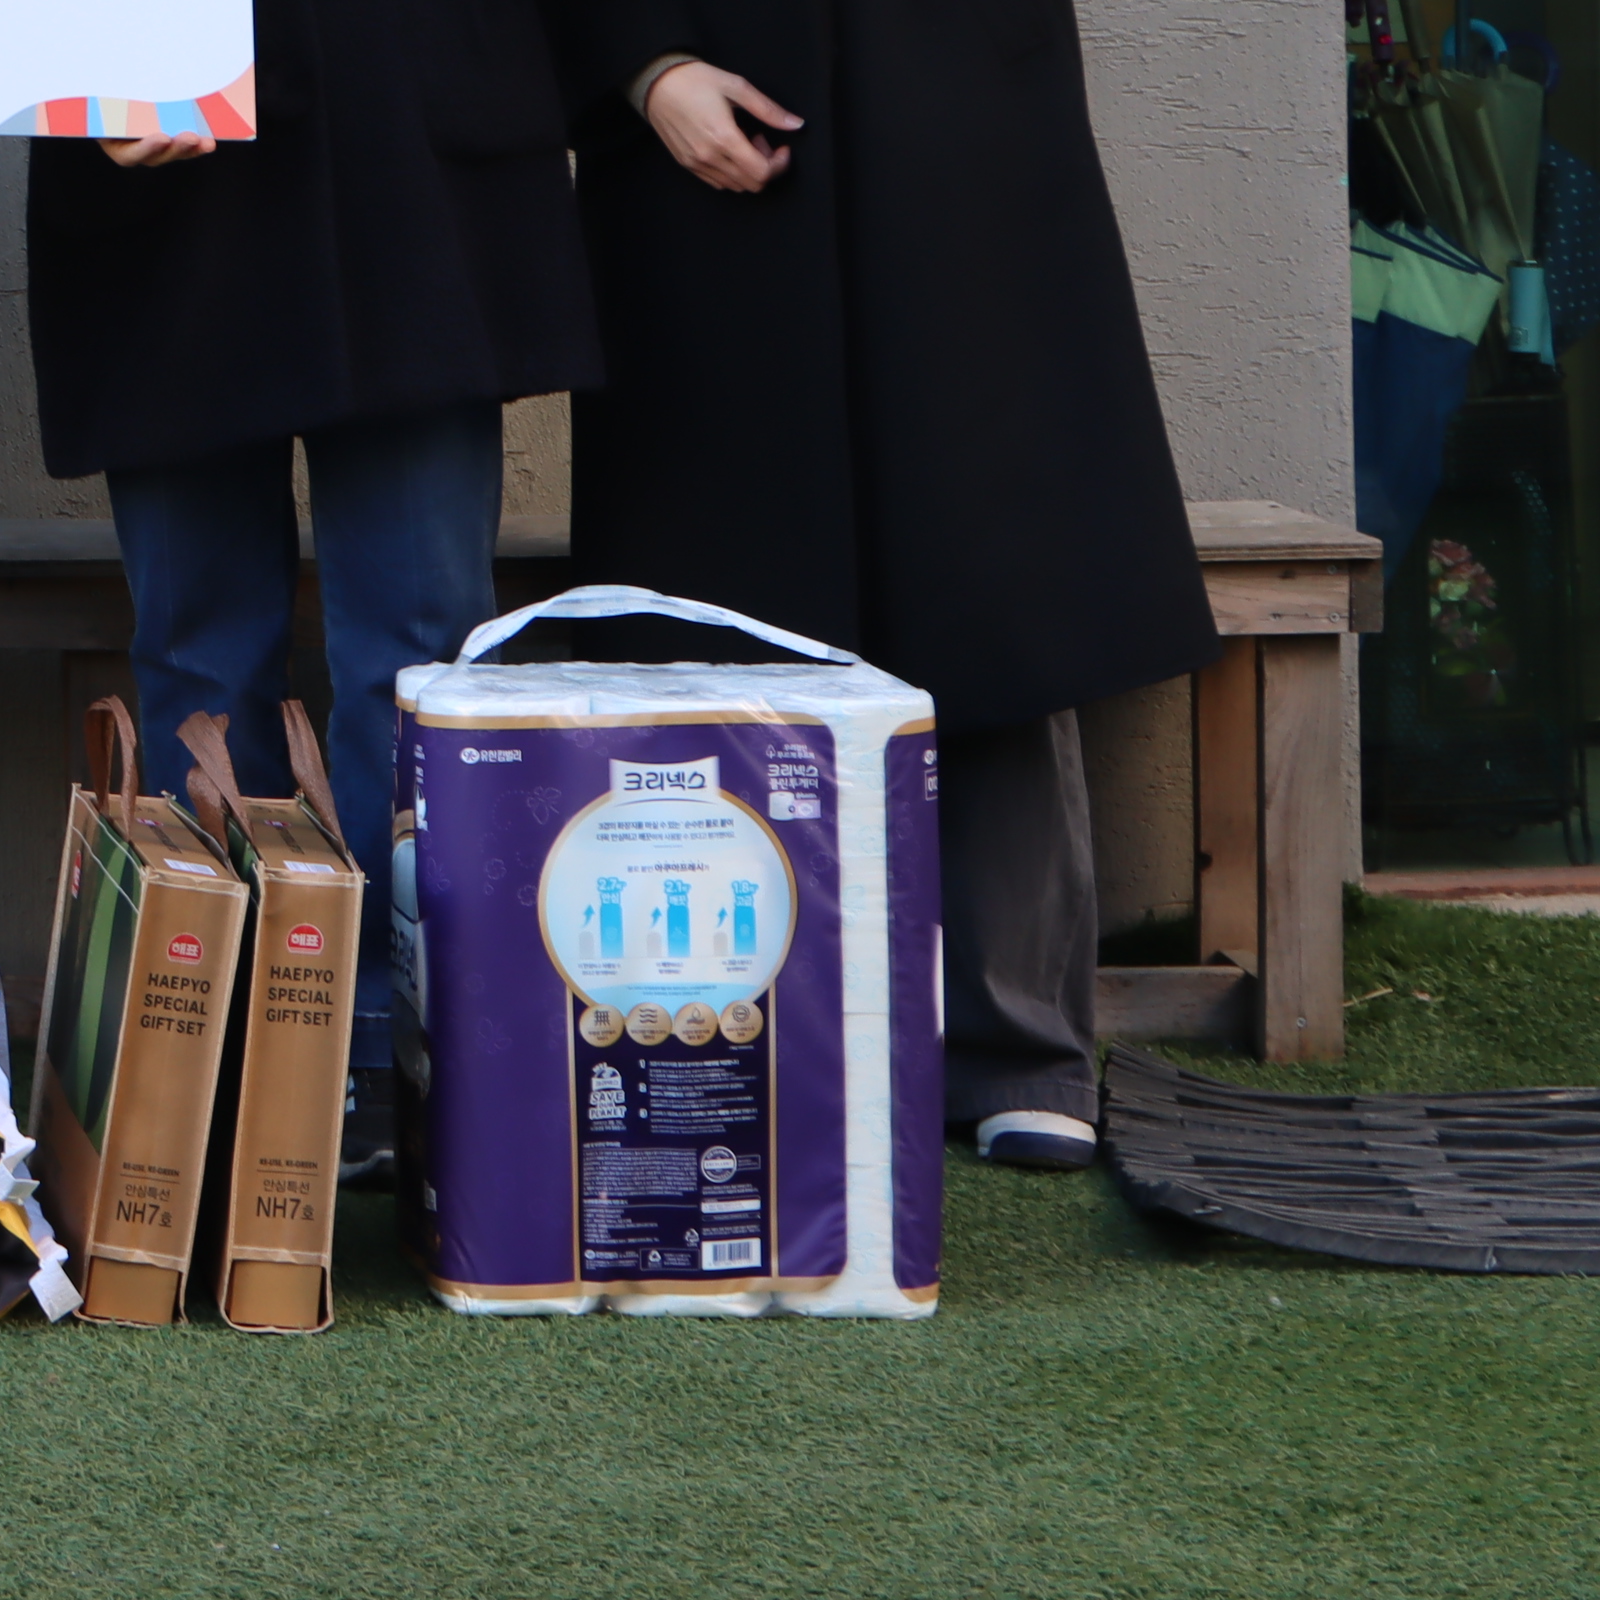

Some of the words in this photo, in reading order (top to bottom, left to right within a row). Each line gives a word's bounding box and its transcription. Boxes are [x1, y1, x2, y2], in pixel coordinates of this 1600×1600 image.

[768, 764, 818, 777] 크리넥스
[624, 770, 707, 791] 크리넥스
[290, 932, 319, 948] 해표
[172, 942, 199, 957] 해표
[270, 965, 334, 983] HAEPYO
[148, 973, 211, 994] HAEPYO
[144, 994, 208, 1016] SPECIAL
[268, 987, 334, 1005] SPECIAL
[140, 1014, 174, 1032] GIFT
[177, 1019, 206, 1036] SET
[266, 1008, 301, 1023] GIFT
[303, 1011, 333, 1026] SET
[592, 1091, 625, 1105] SAVE
[125, 1184, 171, 1201] 안심특선
[263, 1179, 310, 1194] 안심특선
[116, 1200, 172, 1228] NH7호
[256, 1196, 315, 1221] NH7호
